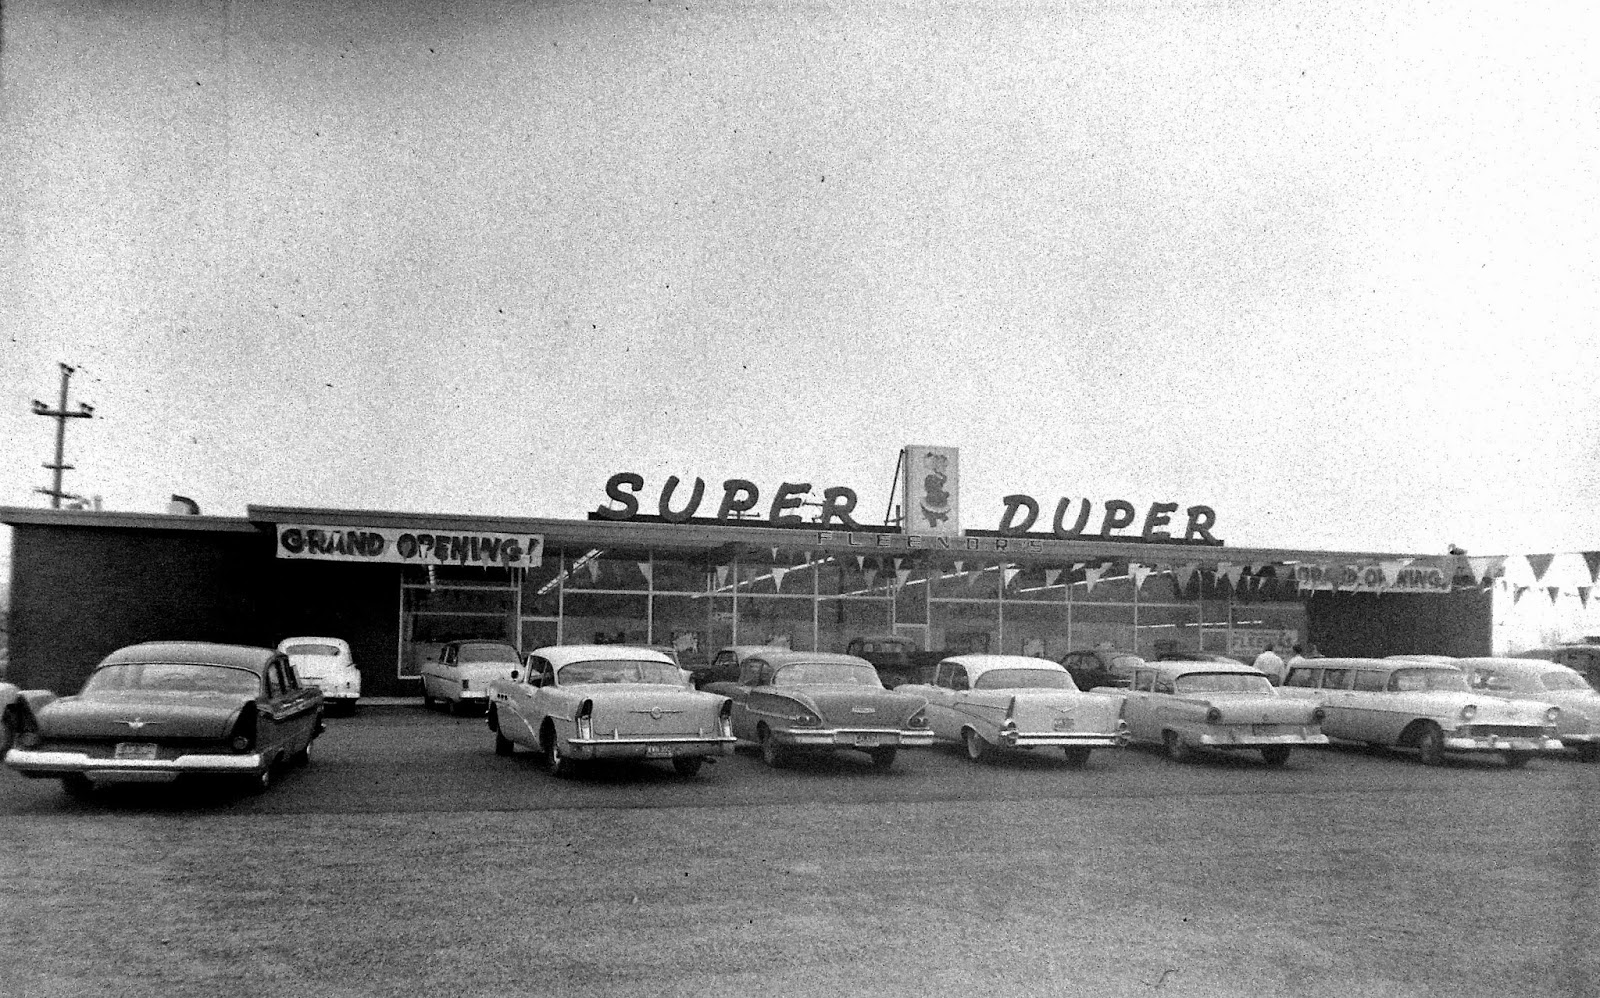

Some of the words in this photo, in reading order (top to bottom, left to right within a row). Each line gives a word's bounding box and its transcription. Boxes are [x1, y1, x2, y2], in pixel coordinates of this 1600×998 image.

[597, 472, 861, 530] SUPER
[999, 494, 1217, 546] DUPER
[280, 528, 385, 557] GRAND
[396, 533, 541, 564] OPENING!
